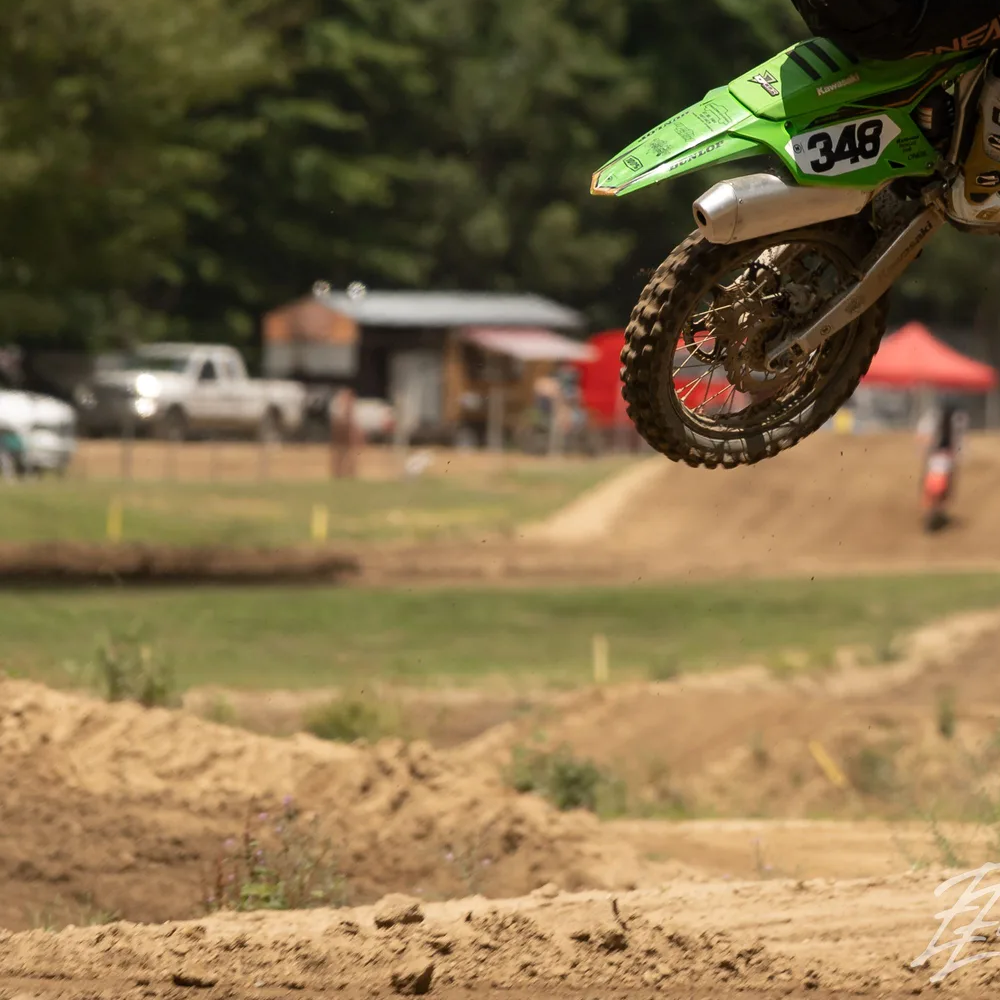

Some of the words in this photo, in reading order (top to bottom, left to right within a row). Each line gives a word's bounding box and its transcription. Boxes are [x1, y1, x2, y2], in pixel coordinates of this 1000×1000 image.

[816, 72, 860, 96] Kawasaki
[669, 140, 725, 171] DUNLOP
[807, 118, 884, 173] 348
